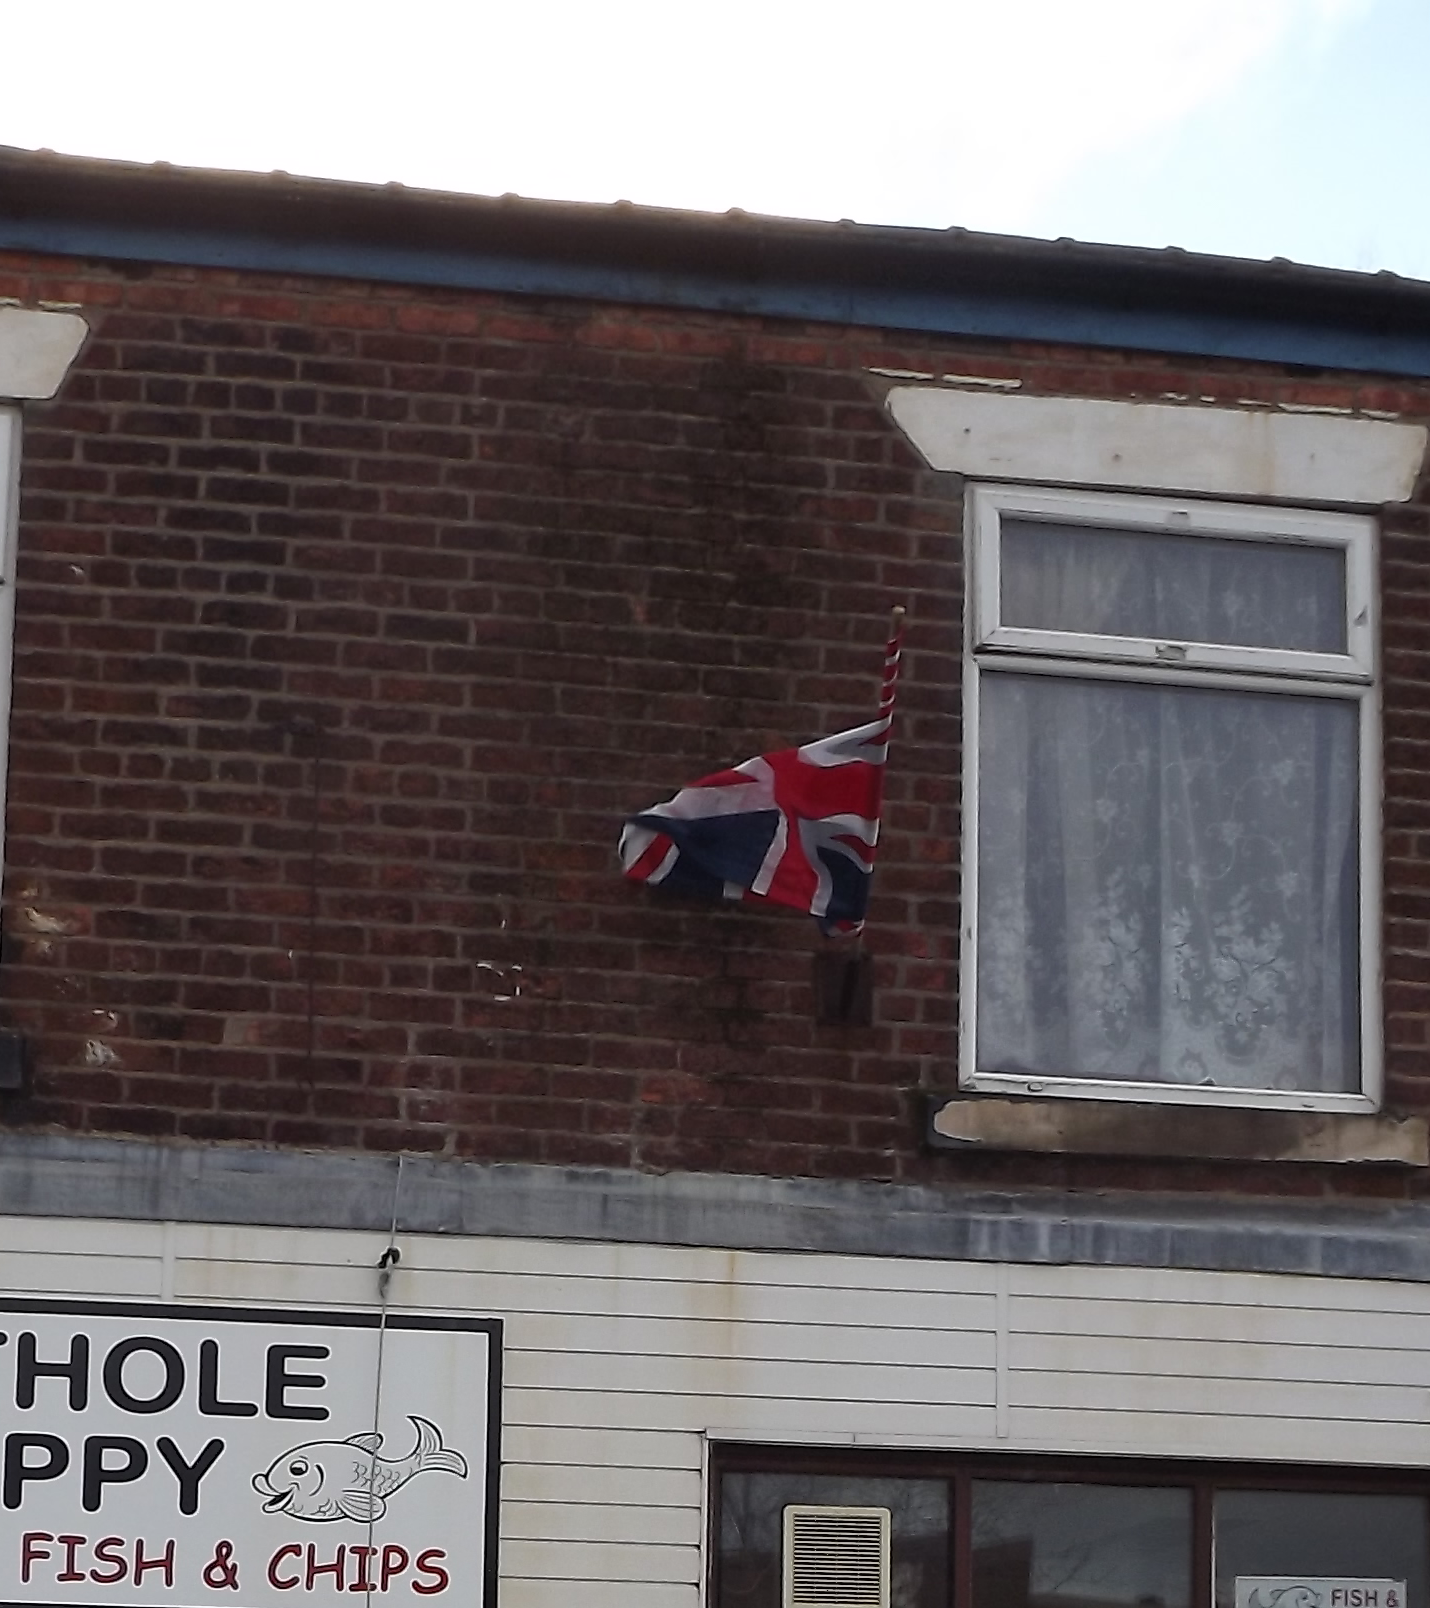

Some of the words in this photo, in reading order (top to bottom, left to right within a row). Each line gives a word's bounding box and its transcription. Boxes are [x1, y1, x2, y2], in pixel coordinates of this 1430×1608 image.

[21, 1531, 176, 1589] FISH
[202, 1539, 241, 1591] &
[267, 1542, 450, 1596] CHIPS
[1330, 1588, 1379, 1608] FISH
[1386, 1588, 1400, 1608] &
